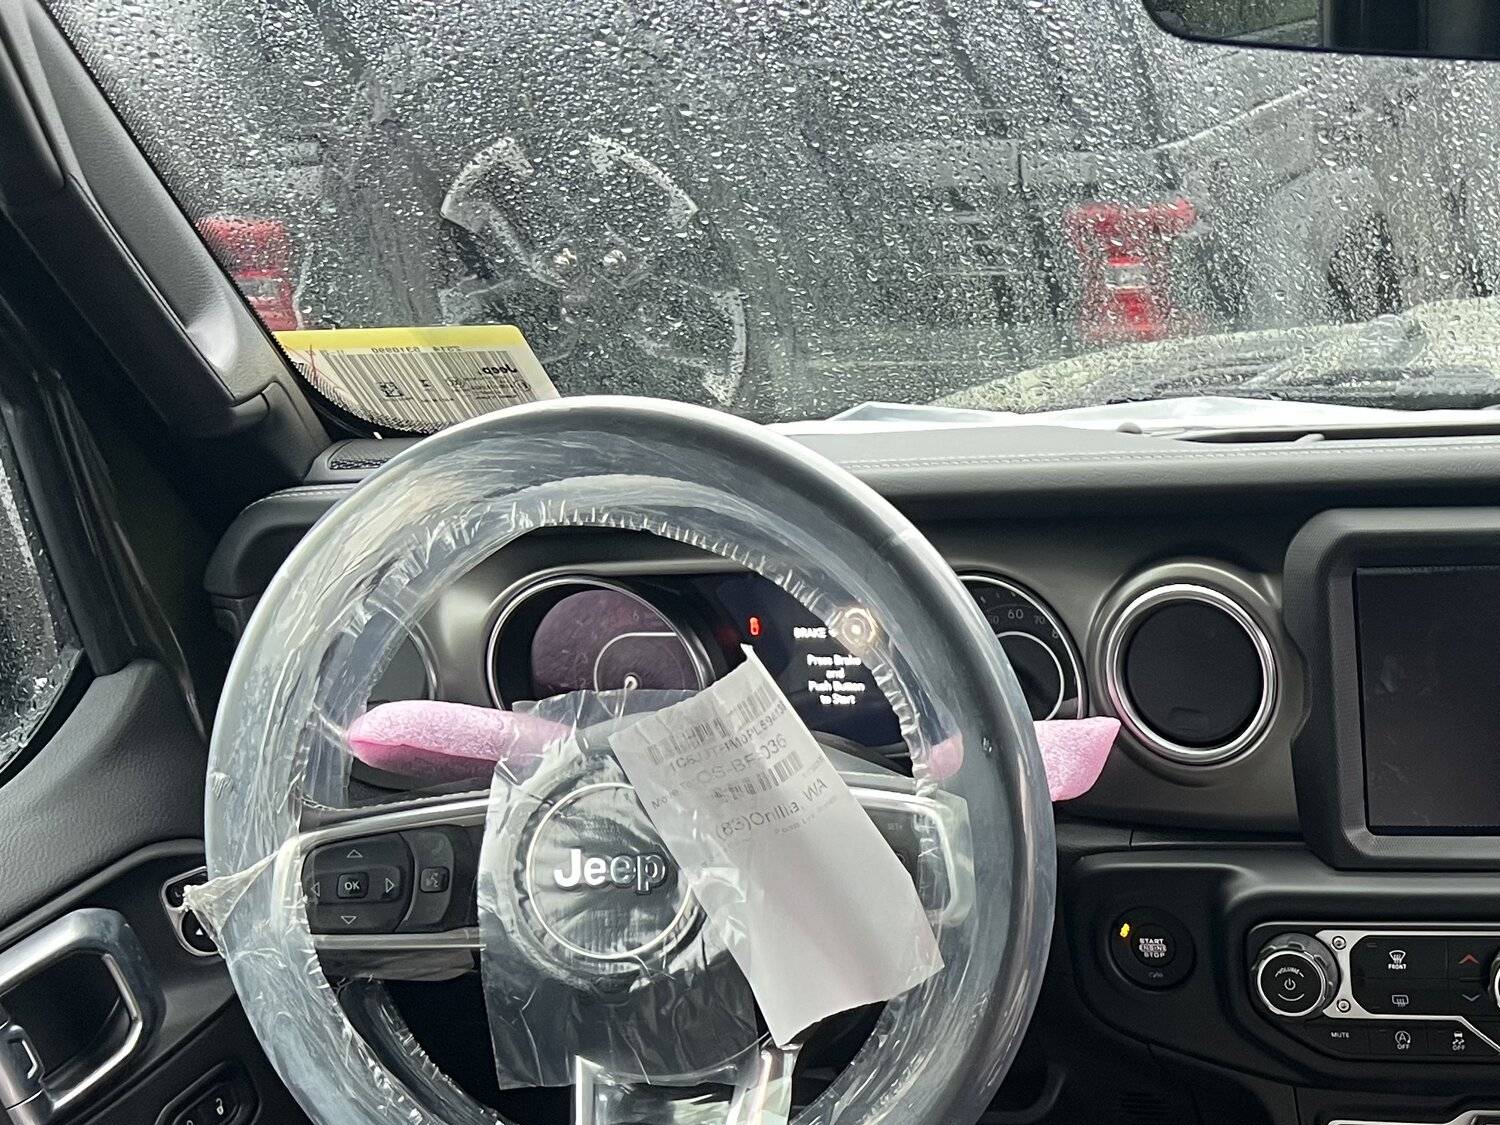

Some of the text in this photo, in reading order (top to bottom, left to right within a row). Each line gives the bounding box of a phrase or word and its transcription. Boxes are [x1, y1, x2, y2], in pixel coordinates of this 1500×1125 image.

[1007, 608, 1024, 619] 60
[802, 775, 829, 802] WA
[553, 848, 667, 893] Jeep
[344, 881, 361, 891] OK
[1452, 1043, 1466, 1051] OFF
